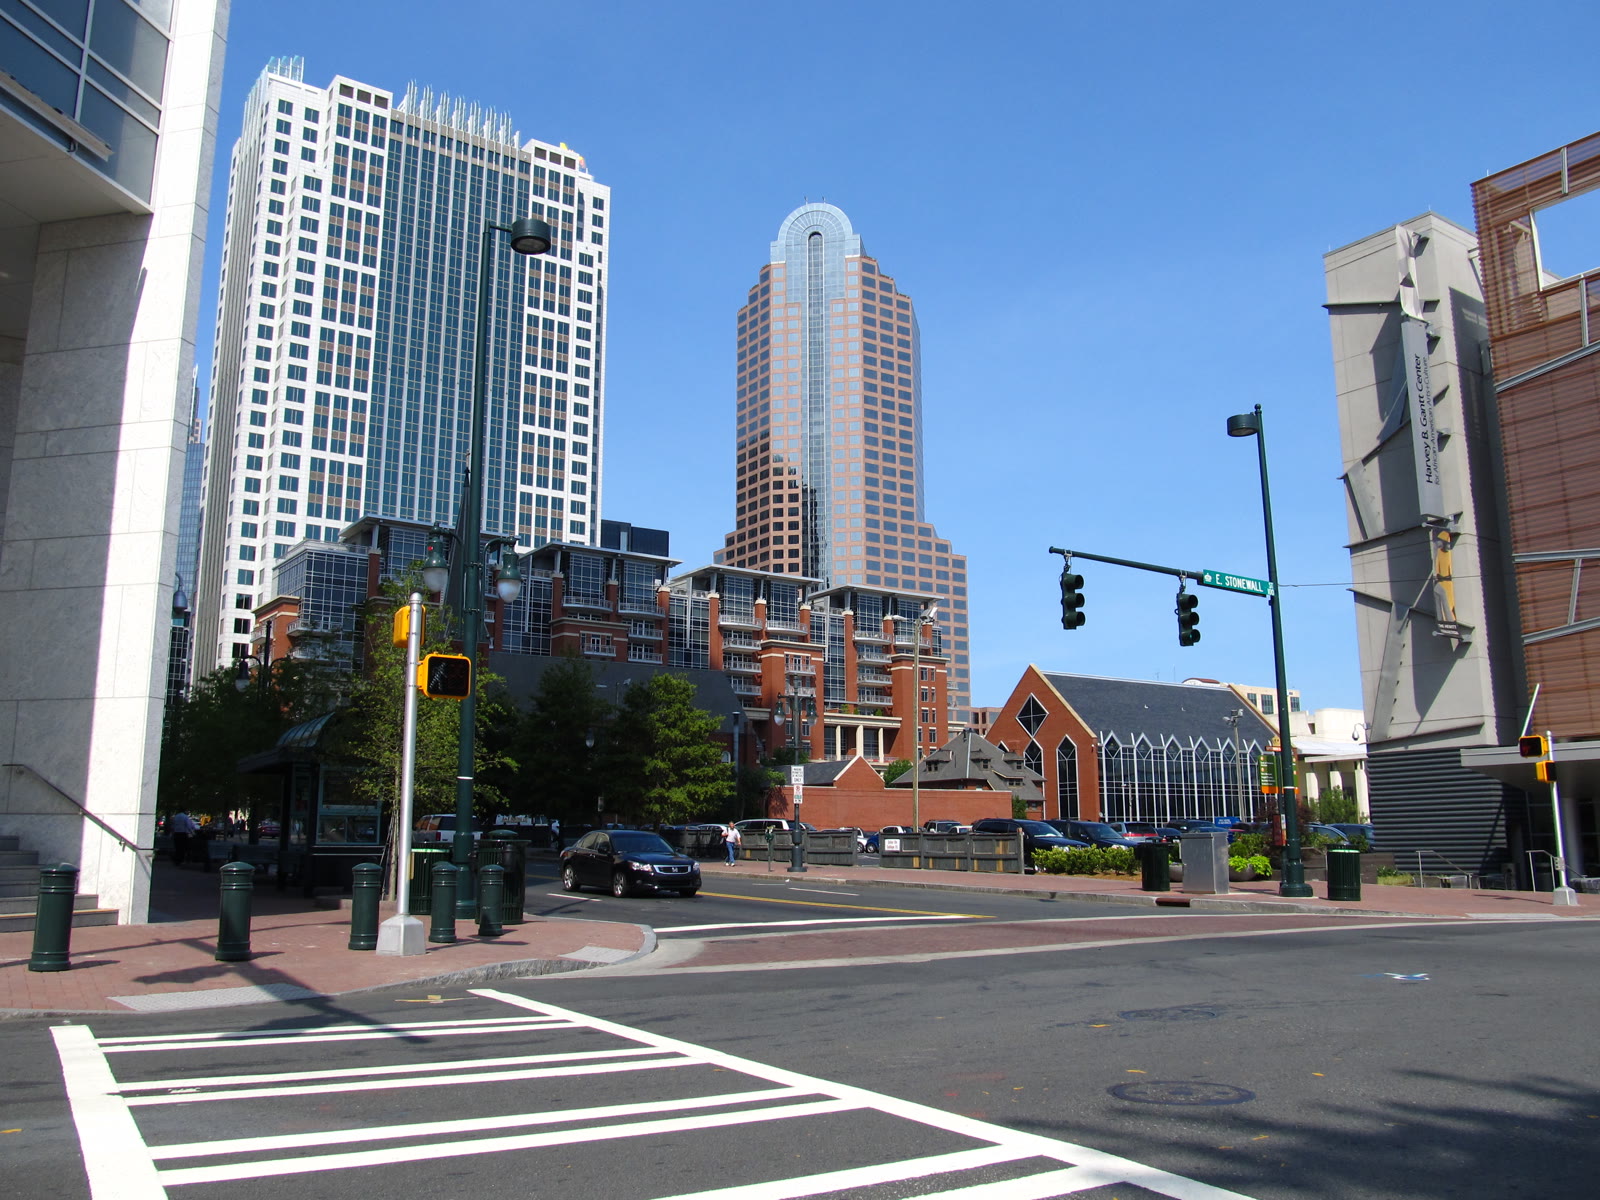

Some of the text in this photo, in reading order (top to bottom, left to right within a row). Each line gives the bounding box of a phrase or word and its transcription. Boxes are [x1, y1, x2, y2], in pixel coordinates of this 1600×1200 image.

[1415, 354, 1433, 483] Harvey B. Gantt Center
[1215, 573, 1263, 592] E. STONEWALL
